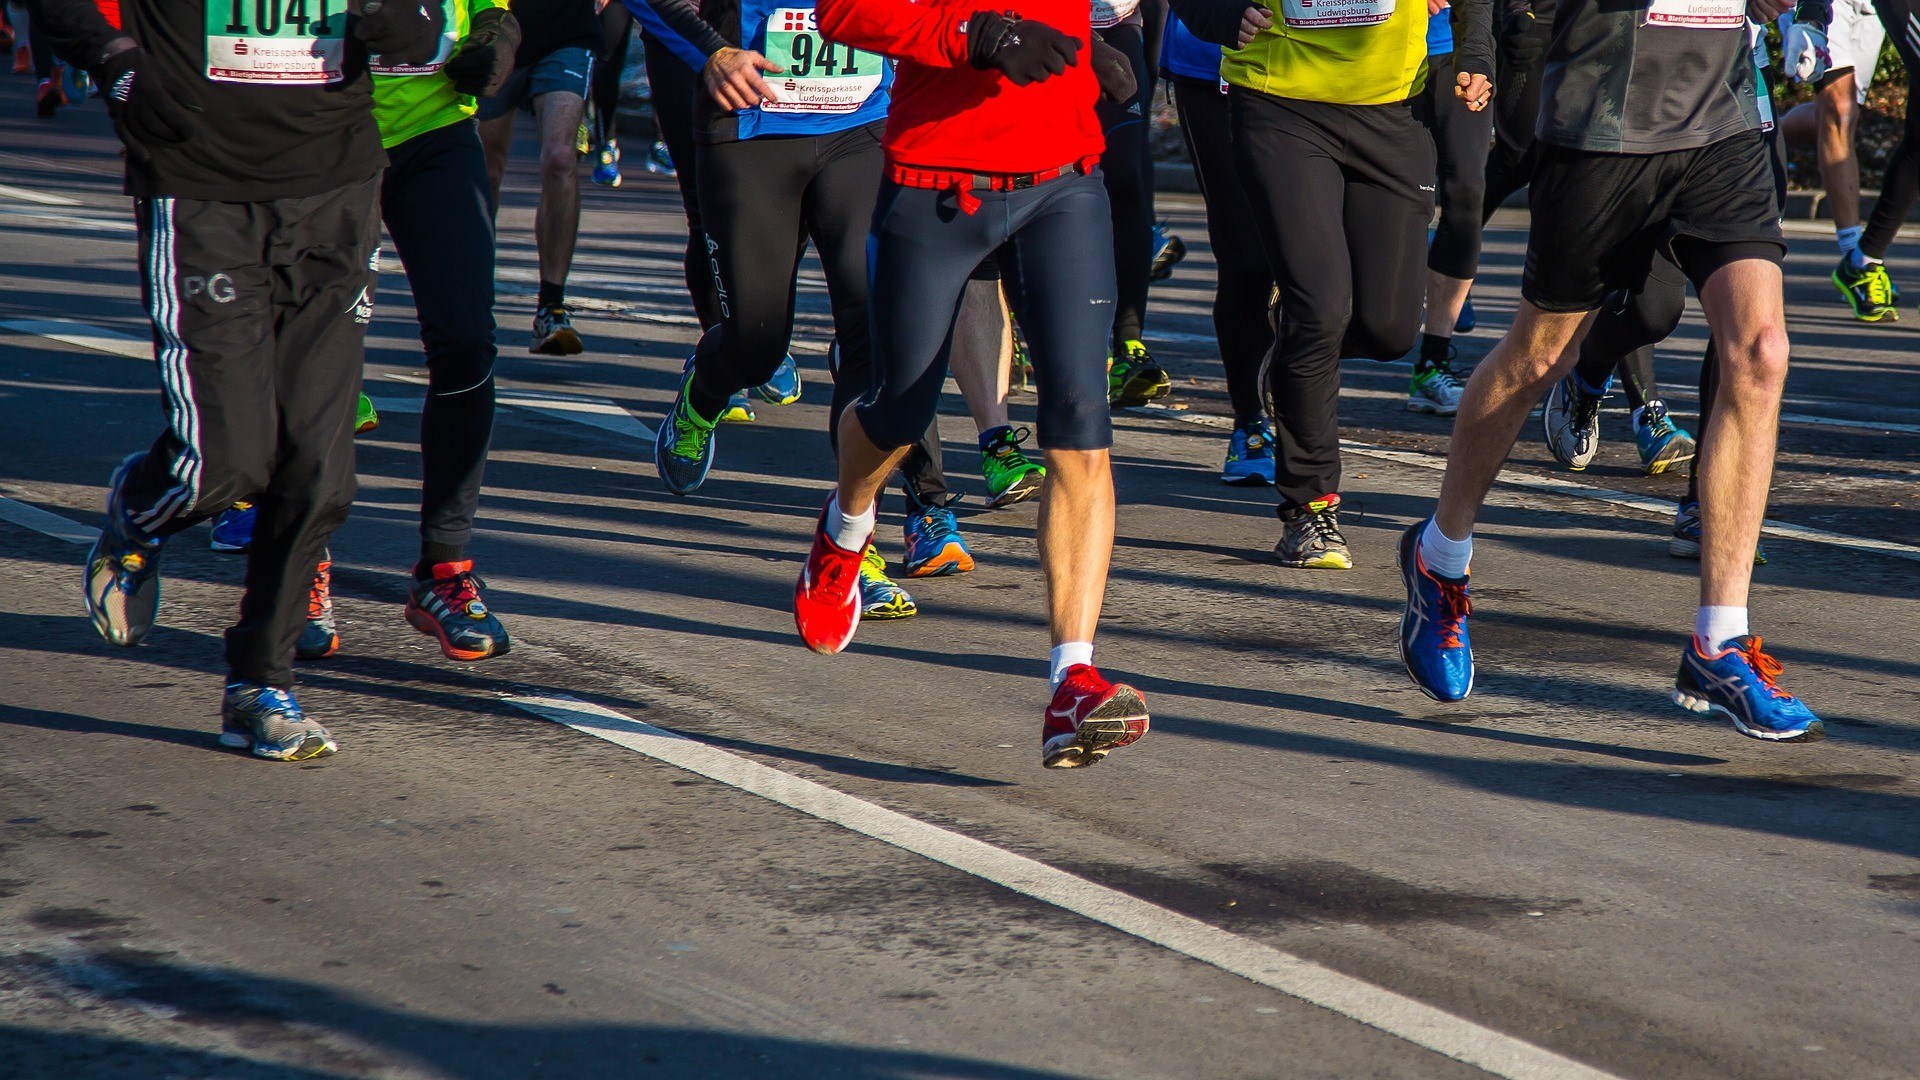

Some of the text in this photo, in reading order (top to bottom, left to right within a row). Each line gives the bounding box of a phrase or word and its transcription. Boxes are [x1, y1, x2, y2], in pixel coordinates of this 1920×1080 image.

[1316, 0, 1378, 8] Kreissparkasse
[1317, 7, 1371, 18] Ludwigsburg
[1687, 5, 1733, 15] Ludwigsburg
[225, 0, 332, 36] 1041
[253, 47, 326, 58] Kreissparkasse
[791, 33, 859, 76] 941
[253, 60, 316, 71] Ludwigsburg
[800, 84, 862, 94] Kreissparkasse
[798, 94, 853, 104] Ludwigsburg
[183, 273, 236, 303] PG
